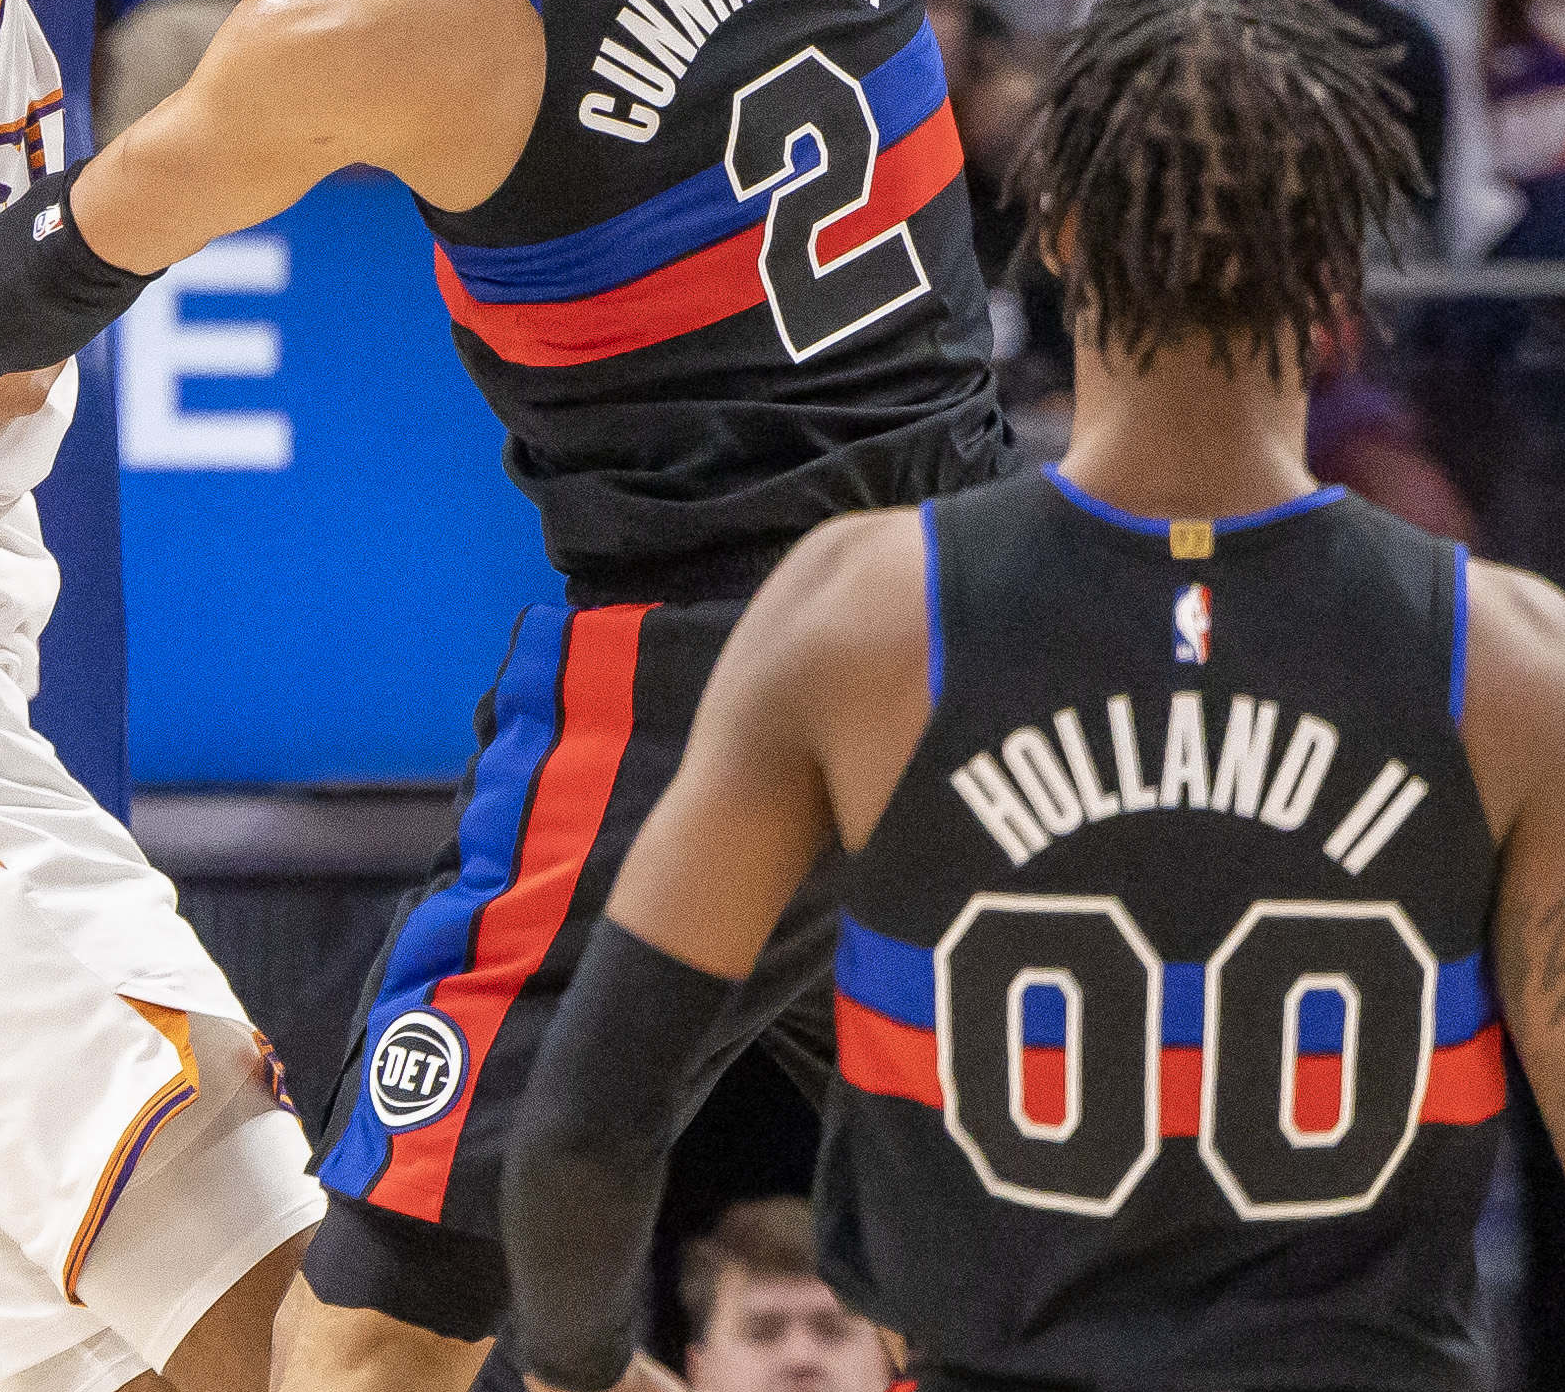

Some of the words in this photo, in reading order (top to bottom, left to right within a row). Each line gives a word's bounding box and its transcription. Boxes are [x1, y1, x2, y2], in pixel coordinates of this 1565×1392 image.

[724, 45, 932, 364] 2
[950, 693, 1338, 867] HOLLAND
[1323, 760, 1428, 875] II
[381, 1045, 446, 1096] DET
[933, 894, 1438, 1221] 00
